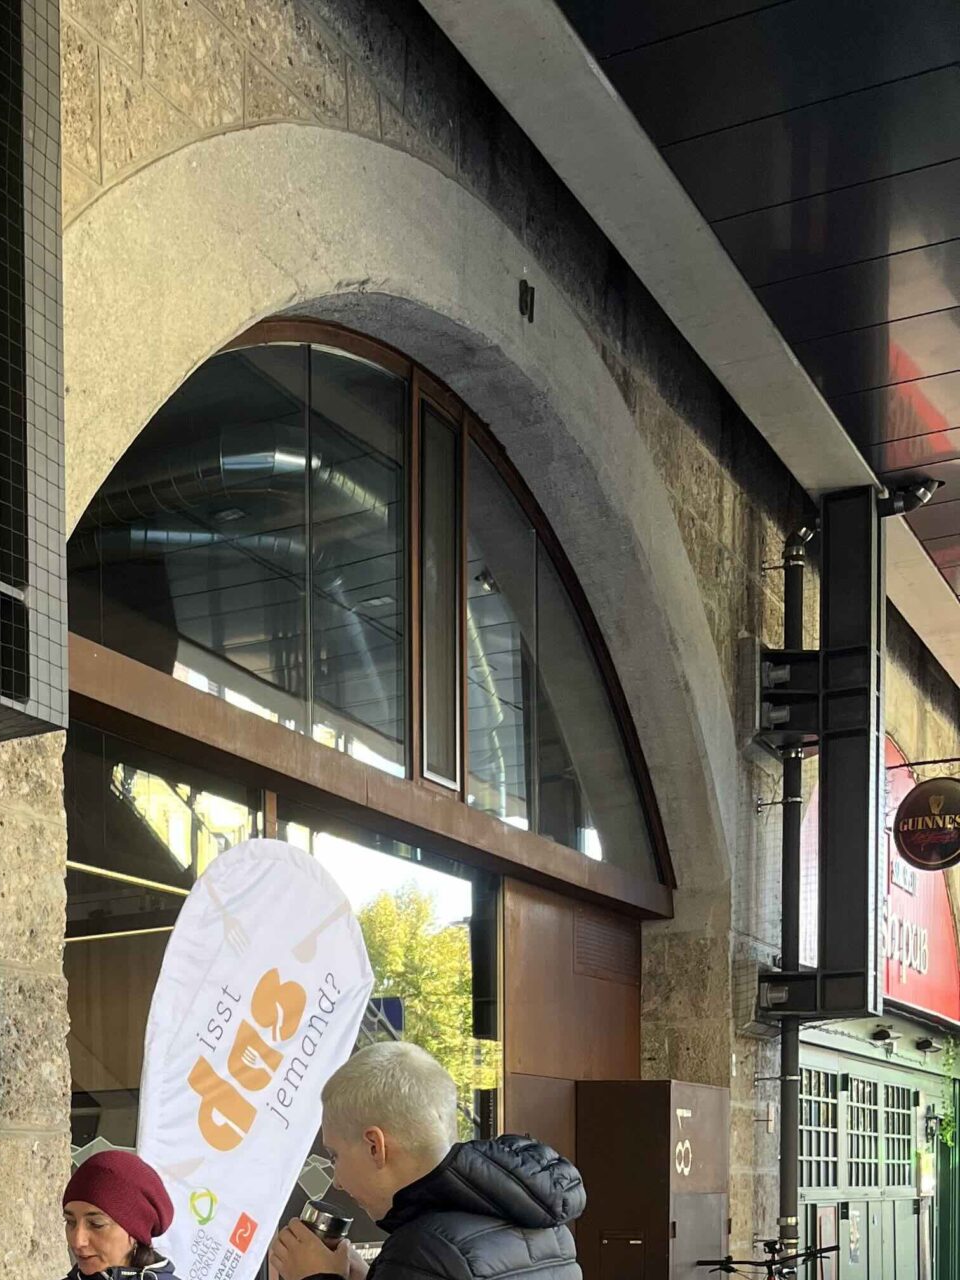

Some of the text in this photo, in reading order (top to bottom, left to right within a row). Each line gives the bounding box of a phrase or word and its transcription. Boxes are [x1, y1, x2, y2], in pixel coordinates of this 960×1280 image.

[899, 814, 960, 832] GUINNES
[196, 984, 241, 1052] isst
[266, 972, 341, 1130] jemand?
[187, 968, 307, 1152] das
[214, 1248, 235, 1280] TAFEL
